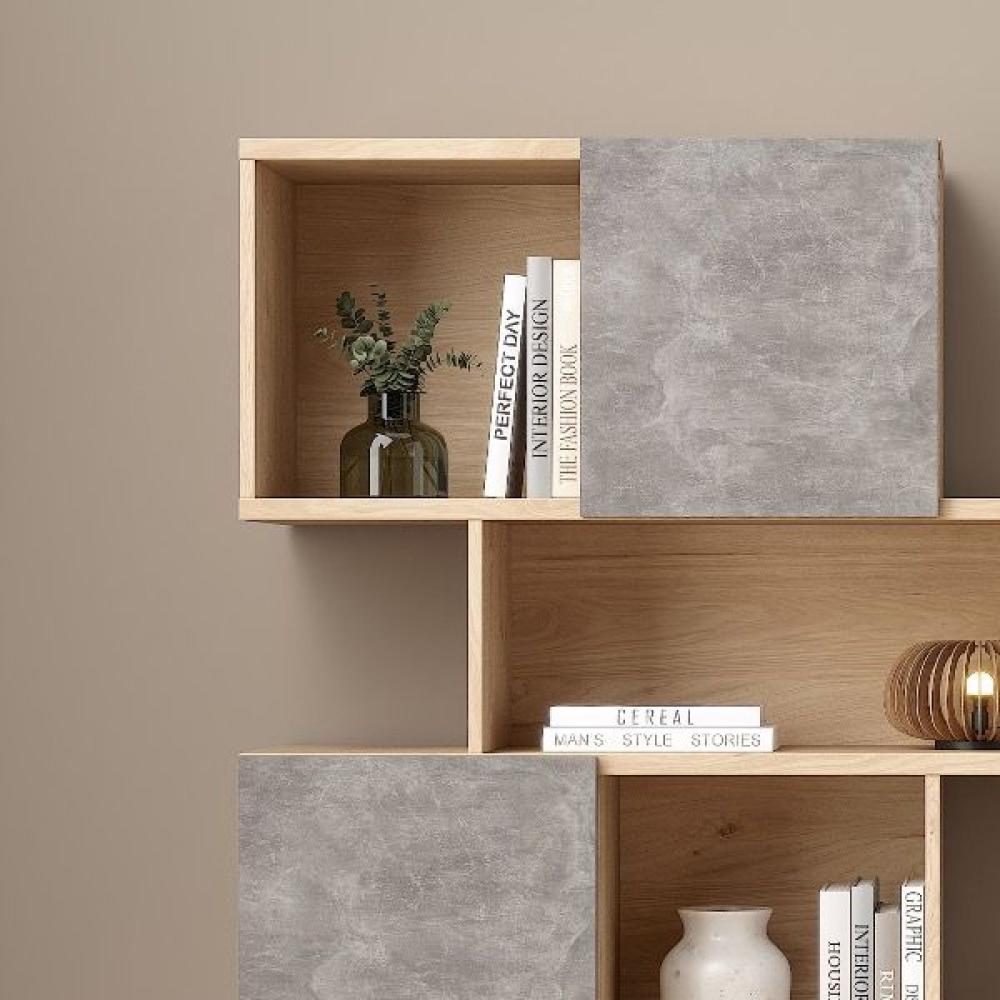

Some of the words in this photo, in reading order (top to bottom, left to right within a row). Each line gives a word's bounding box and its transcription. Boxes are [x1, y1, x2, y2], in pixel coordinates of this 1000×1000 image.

[503, 309, 521, 347] DAY
[532, 300, 549, 366] DESIGN
[560, 344, 578, 386] BOOK
[495, 352, 516, 440] PERFECT
[532, 371, 549, 458] INTERIOR
[560, 388, 578, 452] FASHION
[560, 454, 577, 484] THE
[617, 708, 695, 725] CEREAL
[622, 733, 672, 747] STYLE
[691, 733, 761, 747] STORIES
[904, 891, 922, 962] GRAPHIC
